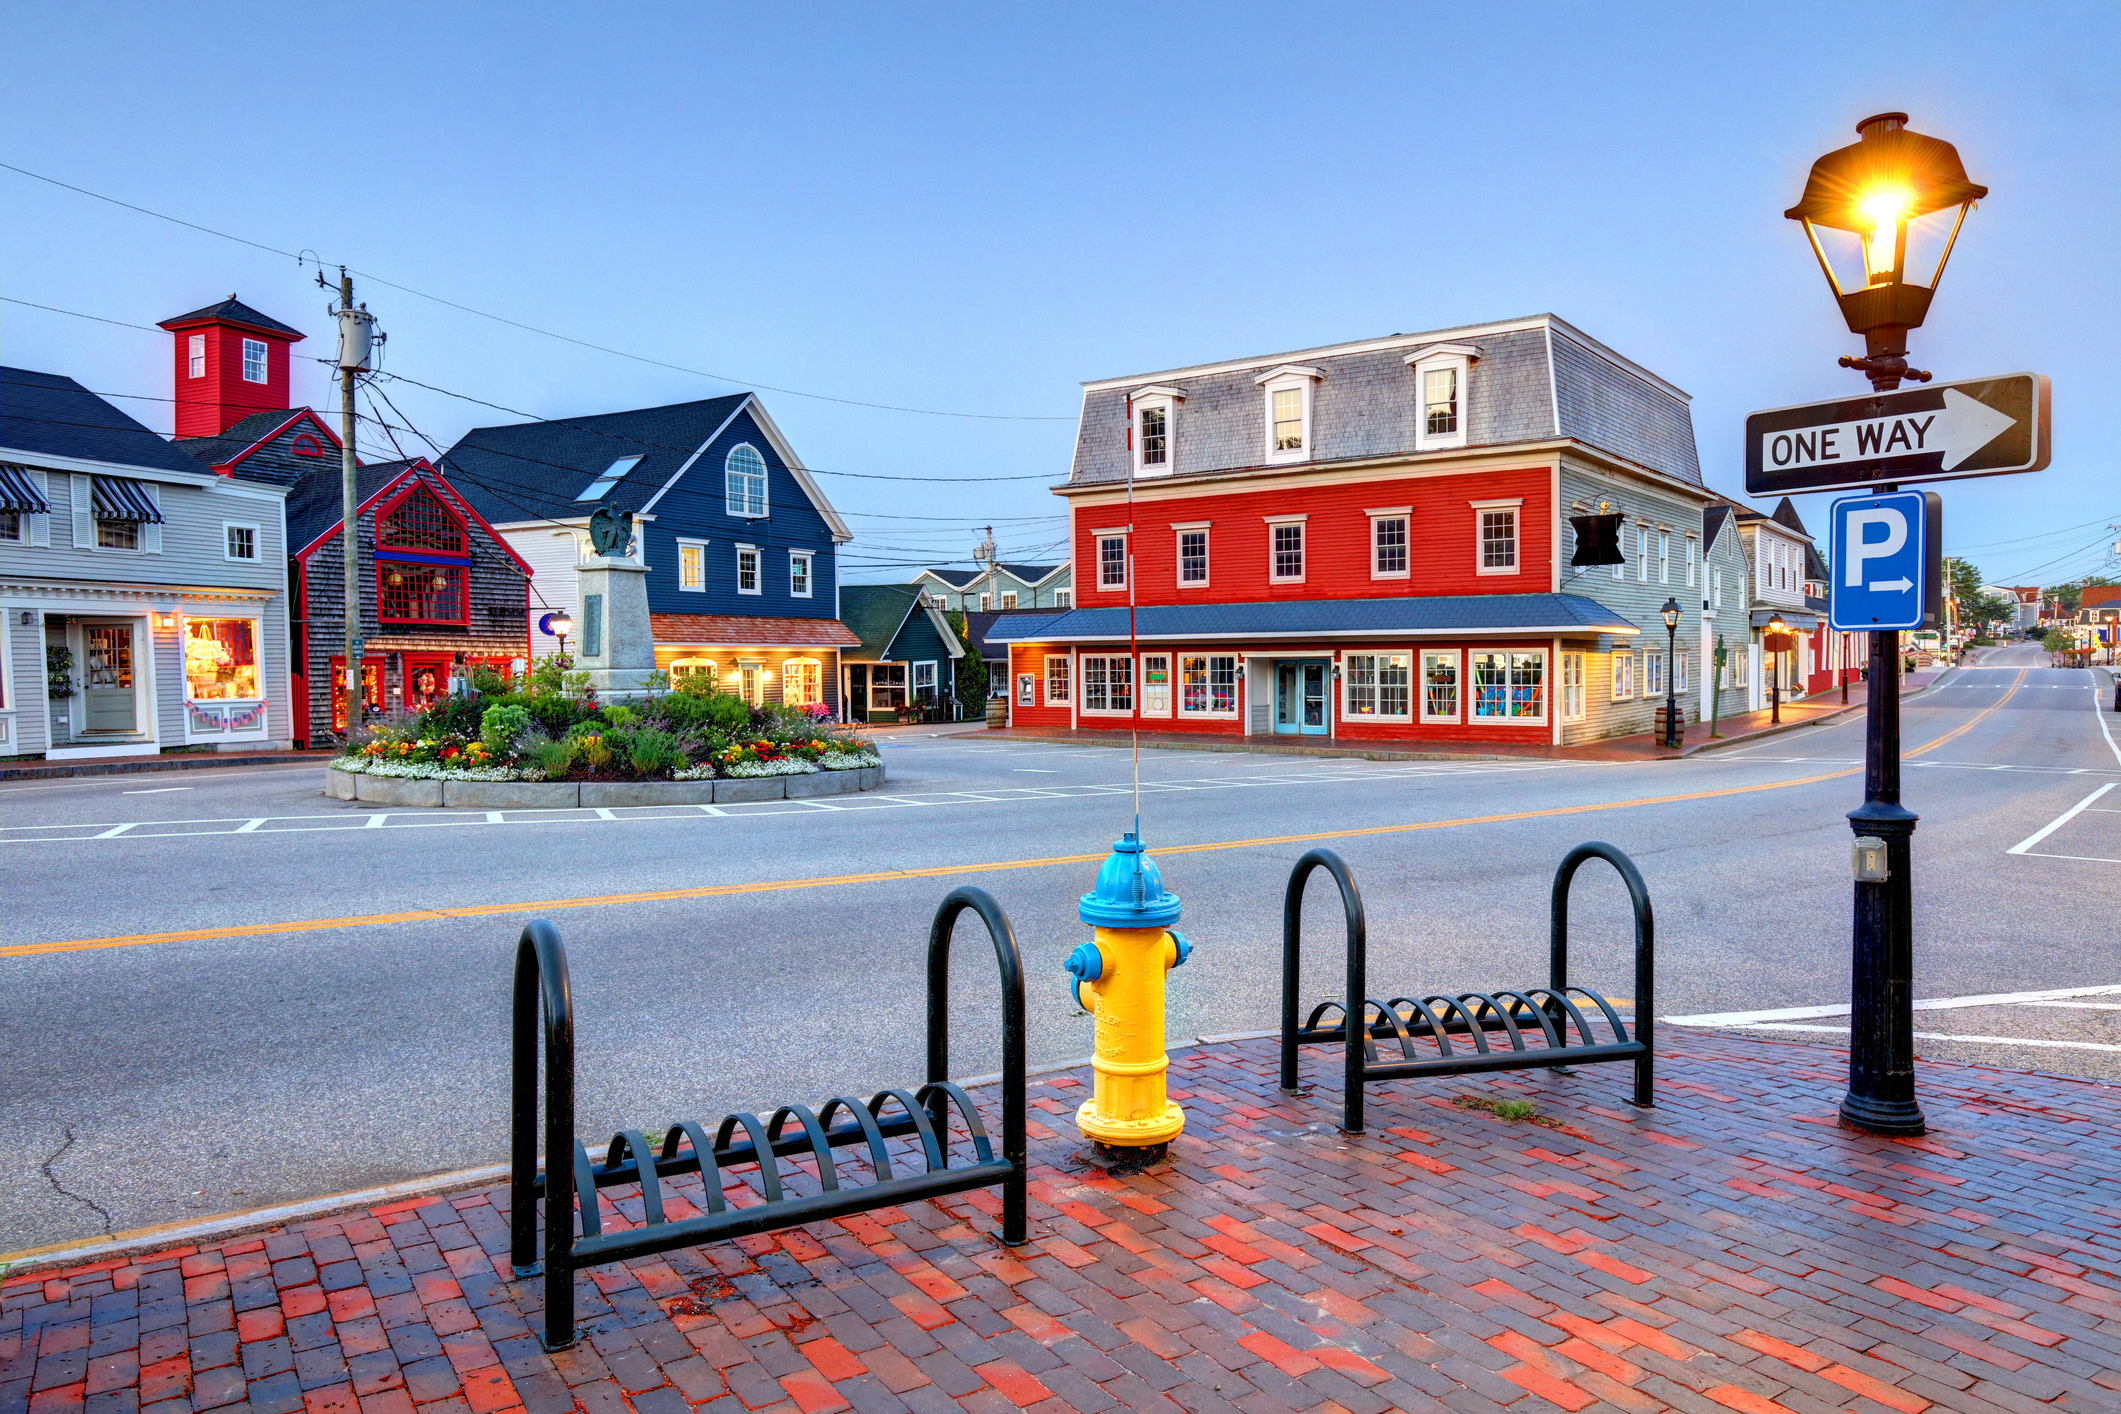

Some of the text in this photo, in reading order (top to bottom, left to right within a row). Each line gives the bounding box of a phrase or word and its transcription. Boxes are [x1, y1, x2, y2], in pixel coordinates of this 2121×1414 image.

[1772, 415, 1936, 465] ONE WAY
[1845, 508, 1908, 587] P
